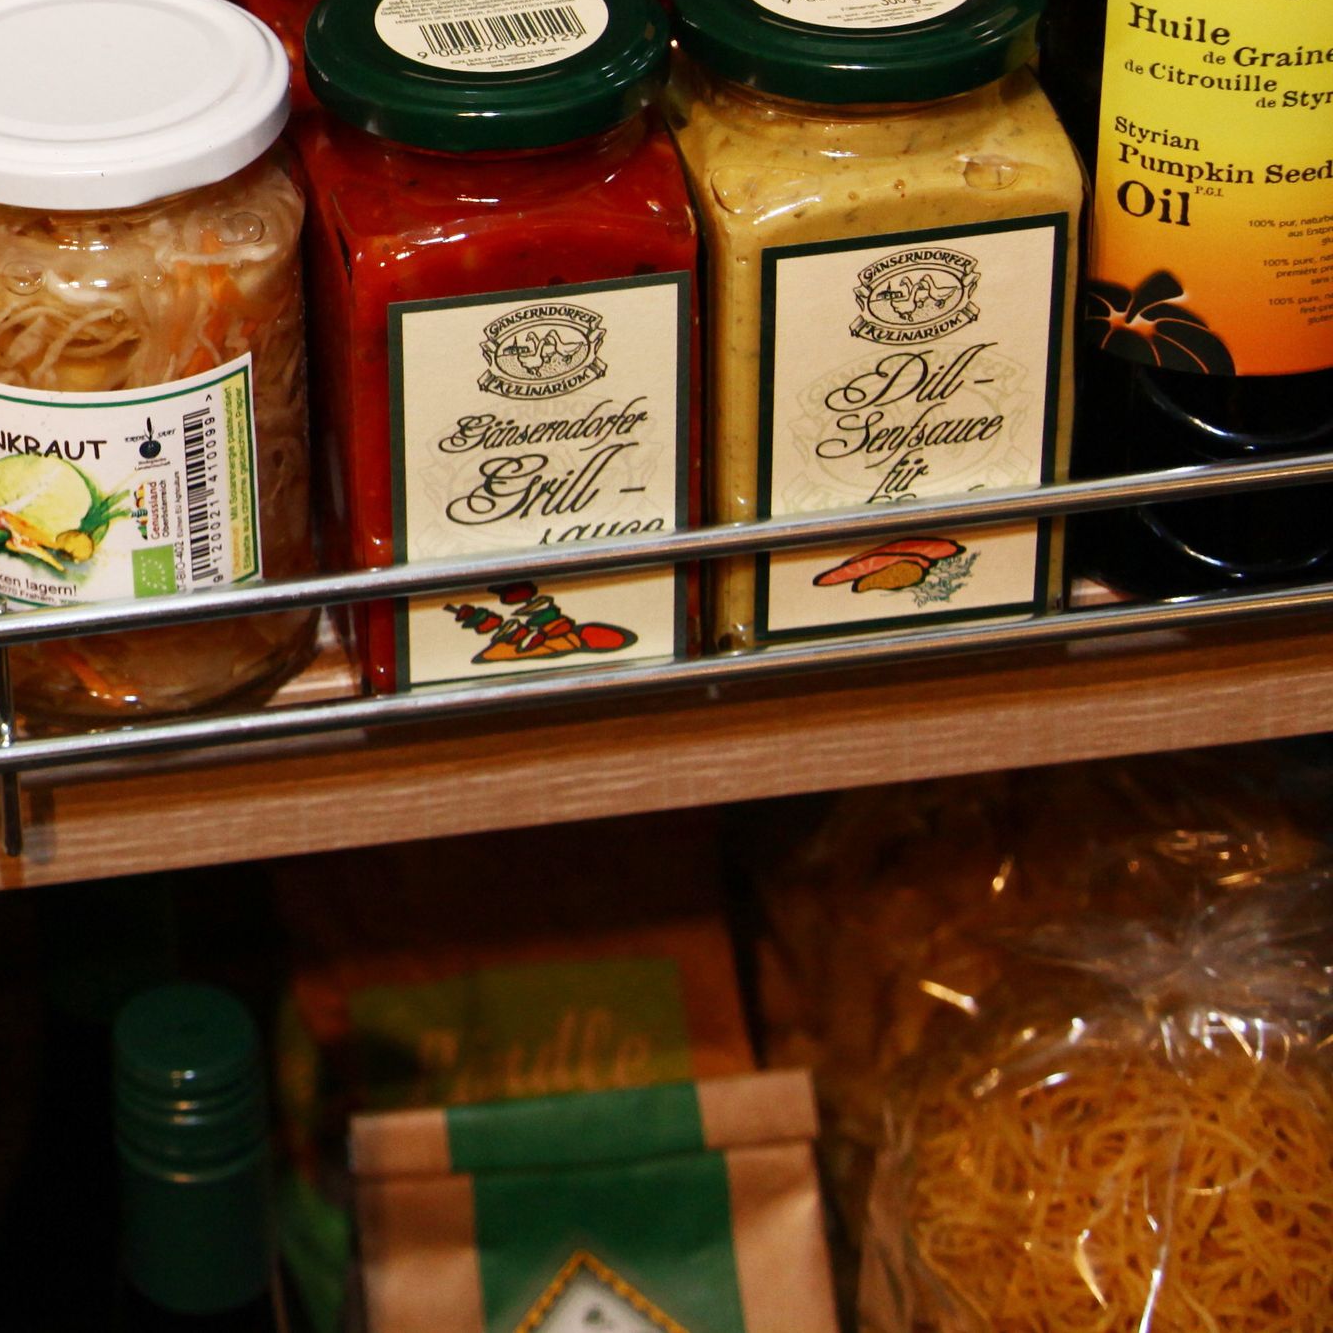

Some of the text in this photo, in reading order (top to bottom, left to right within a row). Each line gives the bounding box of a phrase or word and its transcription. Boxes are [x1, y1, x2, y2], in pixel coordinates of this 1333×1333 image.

[1127, 1, 1232, 46] Huile
[417, 51, 429, 61] 9
[438, 40, 507, 59] 005870
[514, 30, 583, 49] 049129
[1202, 51, 1226, 65] de
[1124, 58, 1278, 93] de Citrouille
[1255, 97, 1277, 108] de
[1114, 116, 1200, 152] Styrian
[1117, 141, 1333, 184] Pumpkin Seed
[1116, 179, 1191, 227] Oil
[1249, 218, 1298, 229] 100% pur,
[1287, 230, 1304, 238] aus
[862, 248, 973, 282] GÄNSERNDORFER
[1263, 258, 1290, 267] 100%
[1269, 297, 1295, 306] 100%
[487, 304, 598, 338] GÄNSERNDORFER
[438, 397, 648, 454] Gänserndorfer
[816, 402, 1004, 460] Senfsauce
[203, 416, 219, 483] 410099
[865, 448, 929, 503] für
[147, 480, 161, 541] Genussland
[158, 478, 171, 539] Oberösterreich
[209, 499, 223, 565] 120021
[24, 577, 78, 598] lagern!
